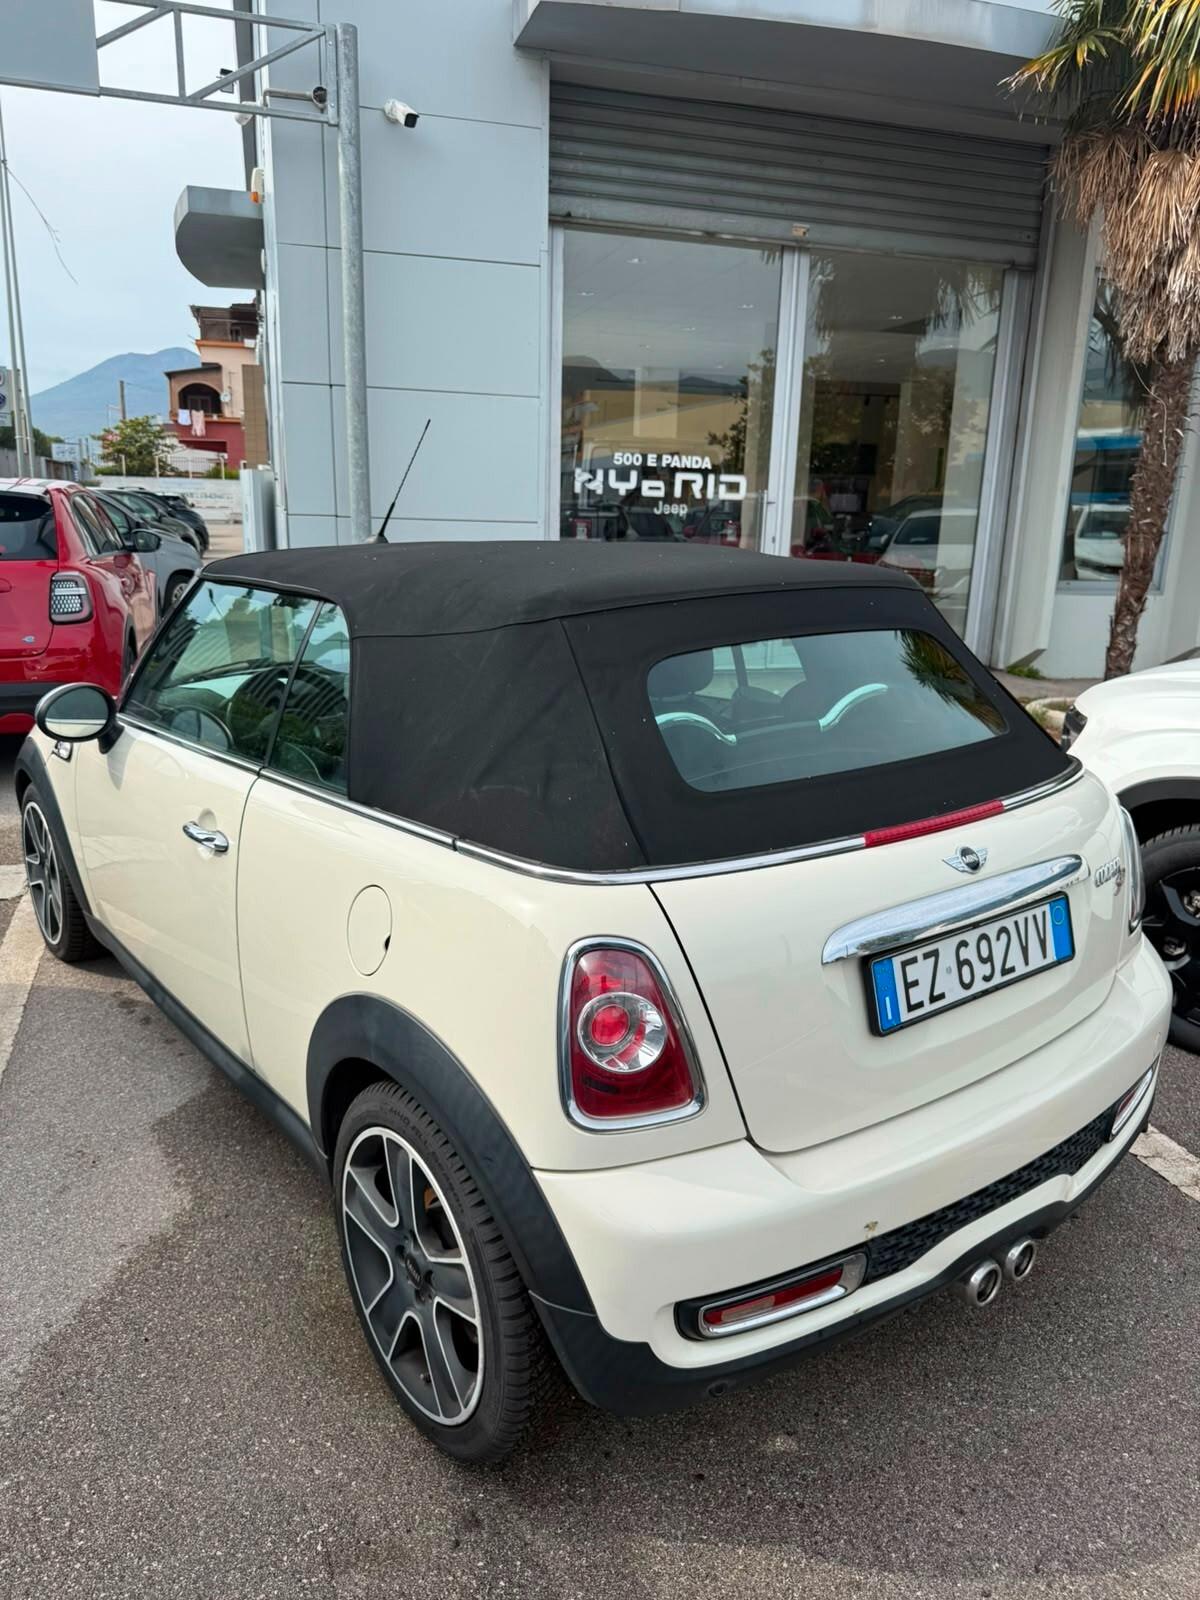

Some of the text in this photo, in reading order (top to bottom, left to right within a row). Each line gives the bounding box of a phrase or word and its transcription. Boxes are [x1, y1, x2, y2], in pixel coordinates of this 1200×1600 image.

[613, 453, 712, 469] 500 E PANDA
[653, 501, 688, 516] Jeep
